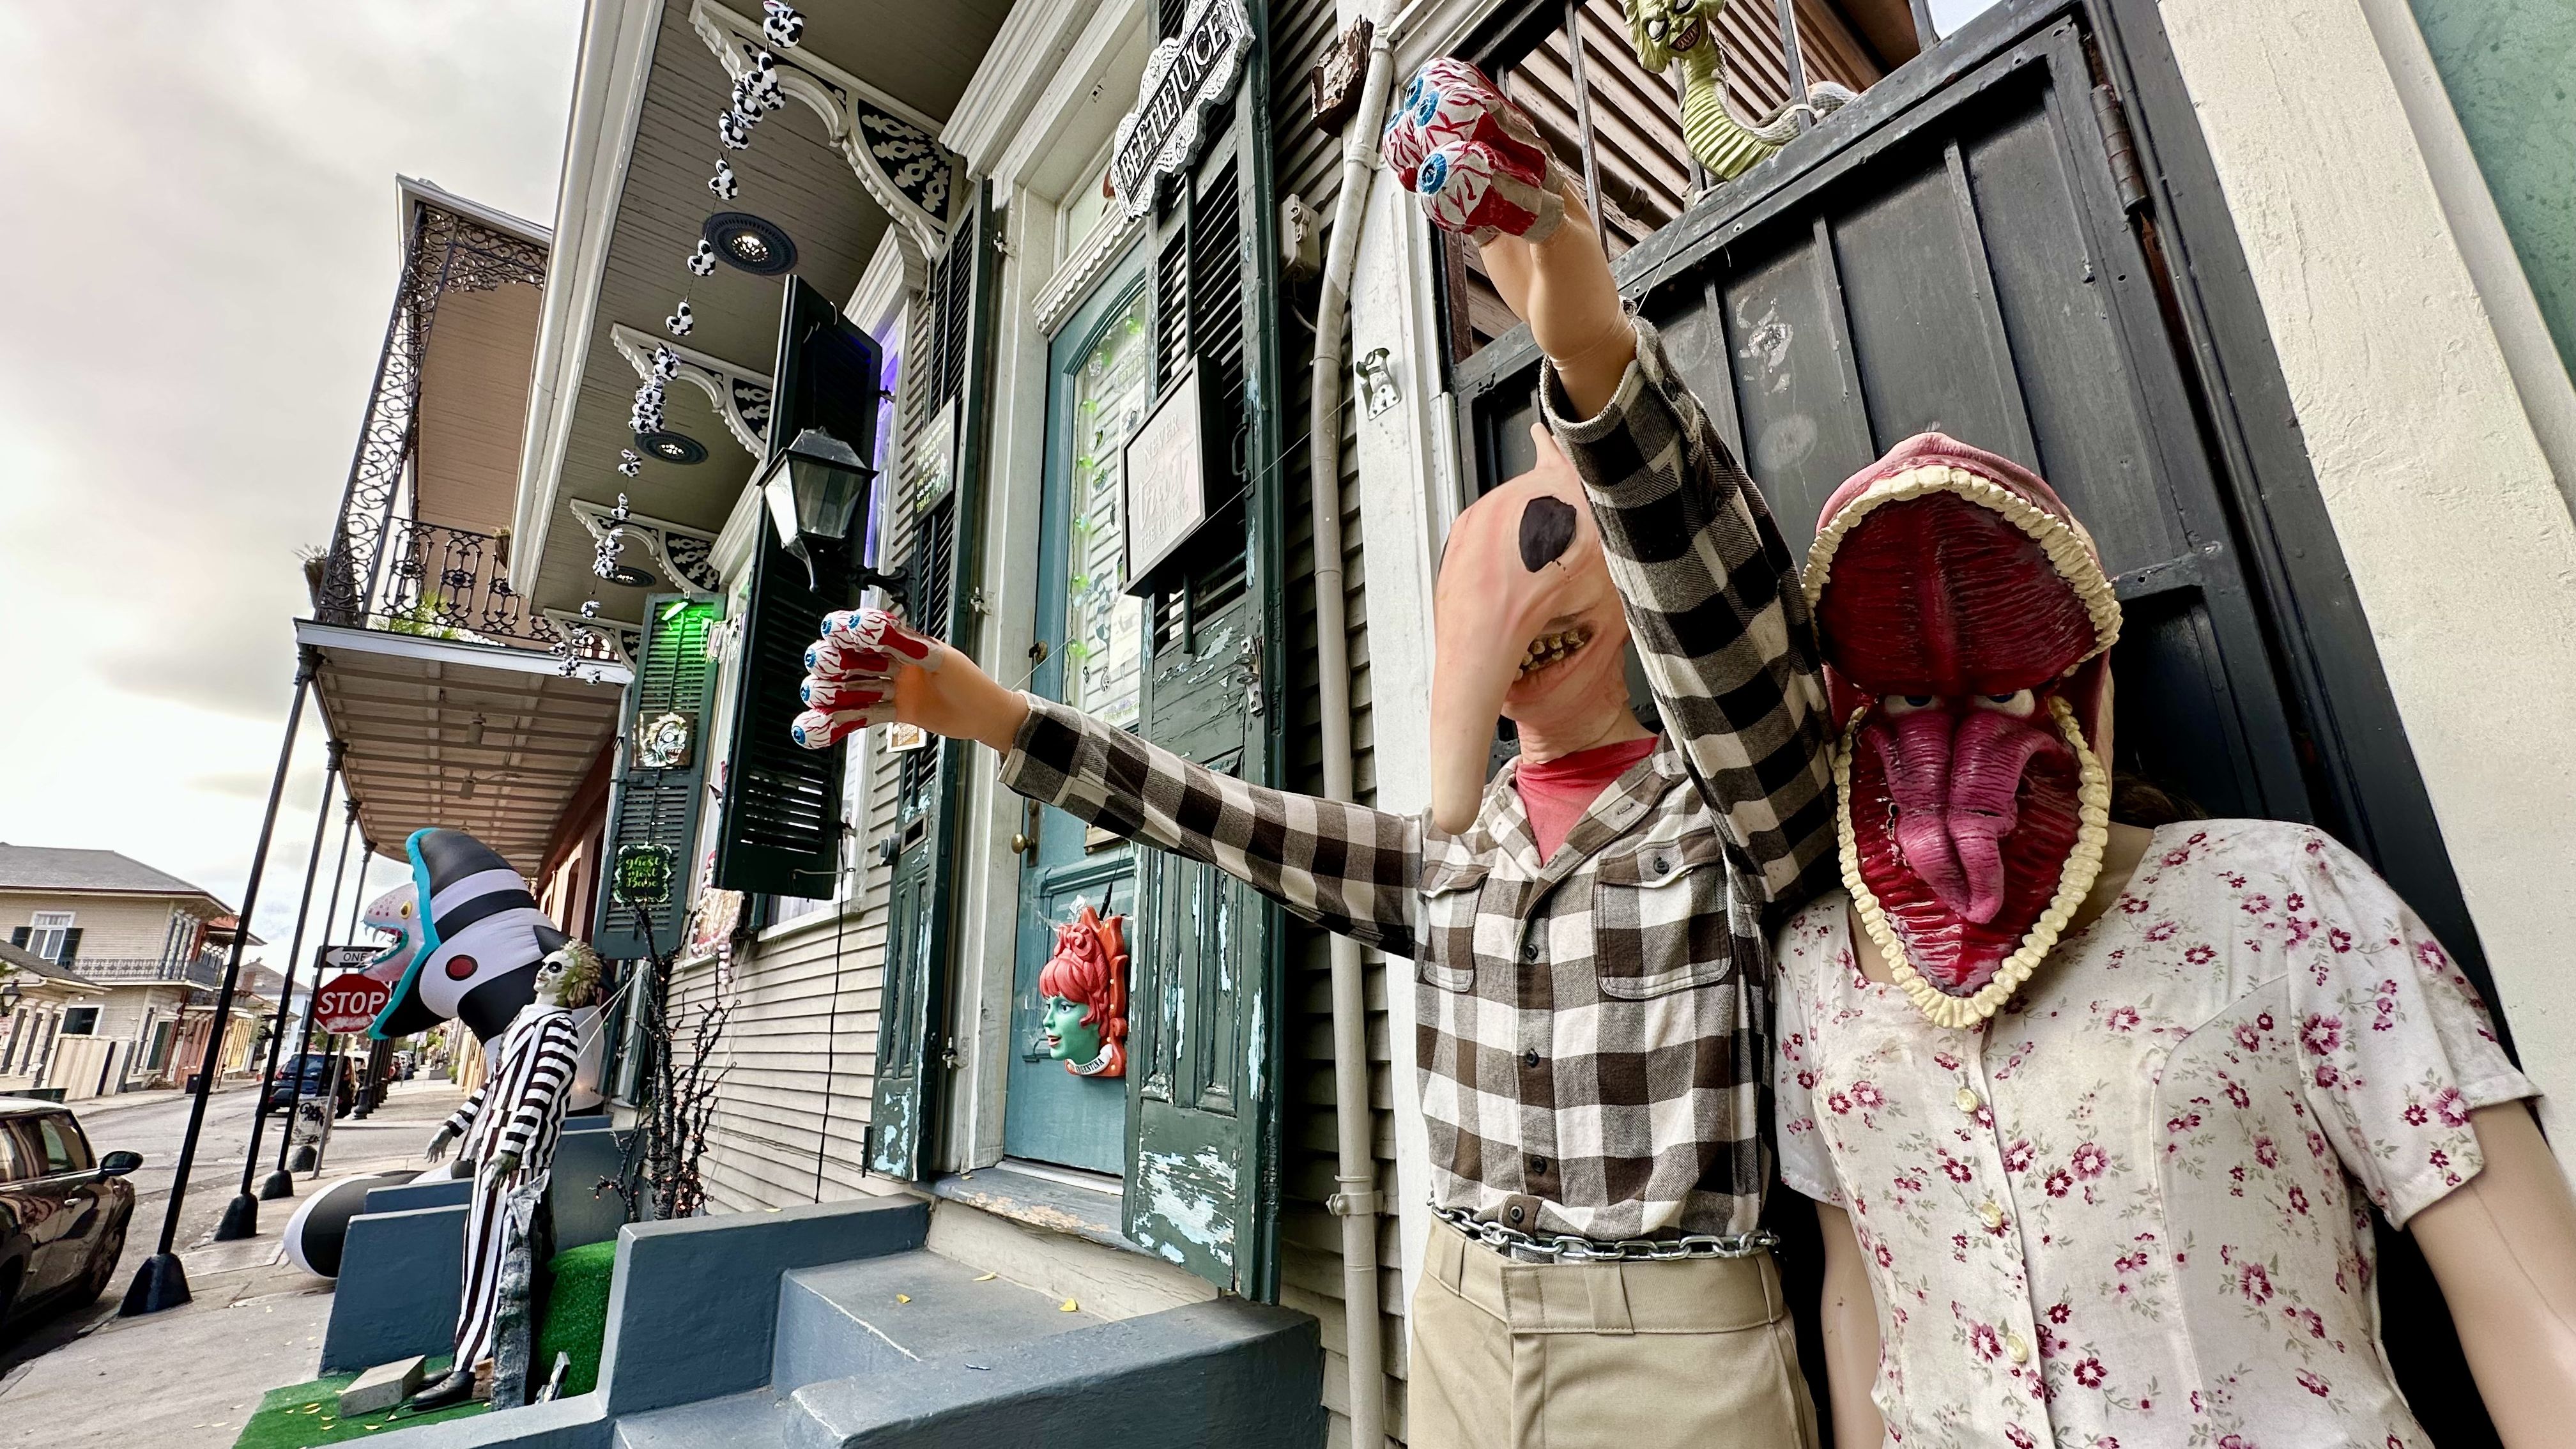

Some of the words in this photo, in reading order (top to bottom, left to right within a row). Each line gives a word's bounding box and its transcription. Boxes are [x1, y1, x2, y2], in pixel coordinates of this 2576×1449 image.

[1119, 8, 1227, 188] BEETLEJUICE
[1144, 414, 1180, 466] NEVER
[1140, 524, 1156, 553] THE
[1158, 493, 1189, 537] LIVING
[343, 952, 367, 962] ONE
[318, 991, 385, 1015] STOP
[1074, 1057, 1105, 1074] RGENTINA
